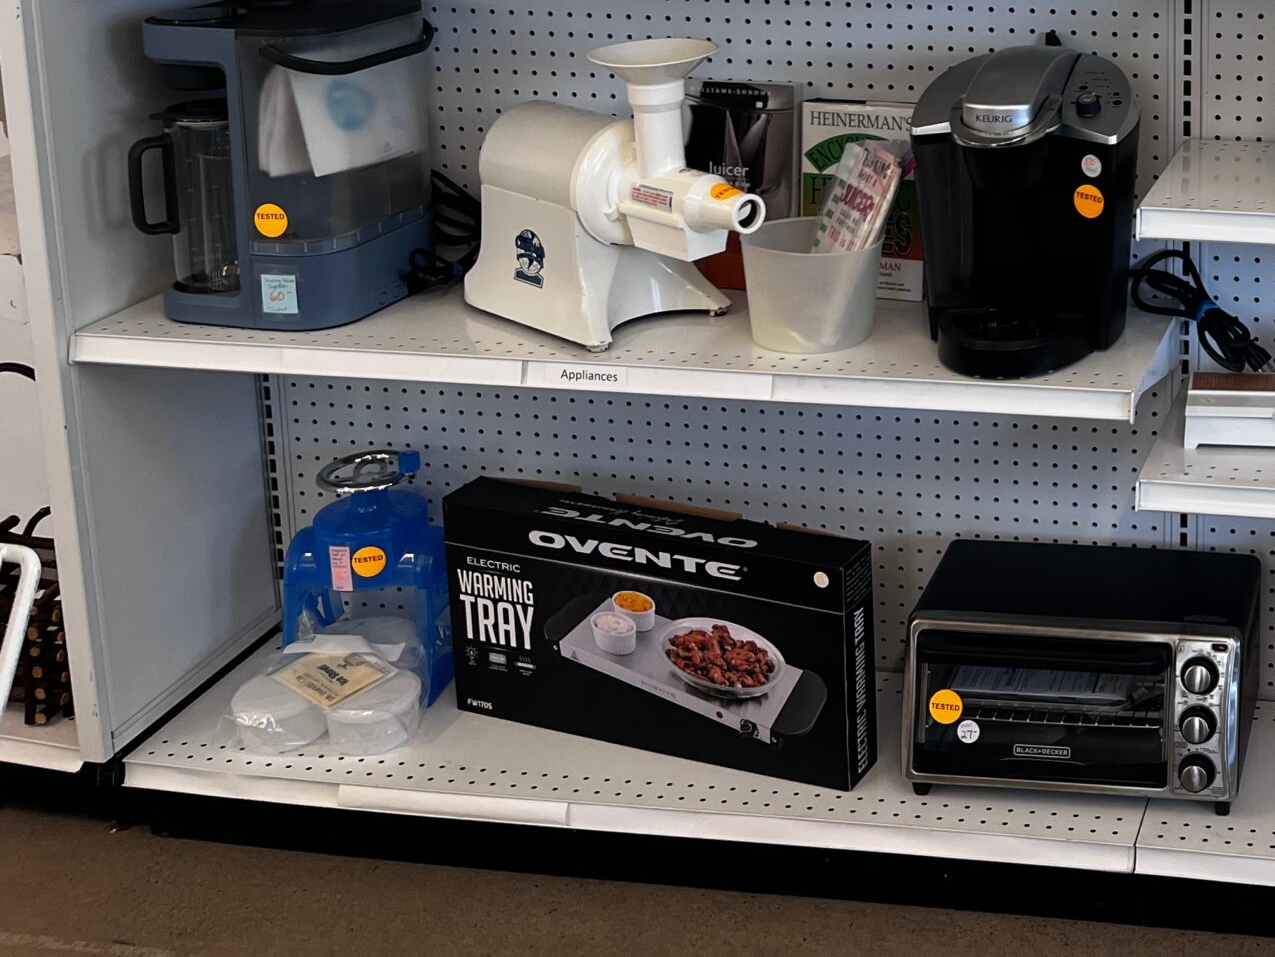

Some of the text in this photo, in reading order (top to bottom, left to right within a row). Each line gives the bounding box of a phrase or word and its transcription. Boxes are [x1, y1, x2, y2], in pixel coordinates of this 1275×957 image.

[810, 110, 913, 132] HEINERMAN'S
[975, 114, 1013, 124] KEURIG
[1076, 191, 1103, 204] TESTED
[560, 369, 618, 382] Appliances
[540, 506, 758, 548] OVENTE
[353, 555, 383, 563] TESTED
[529, 530, 742, 581] OVENTE
[467, 556, 521, 573] ELECTRIC
[457, 569, 534, 606] WARMING
[459, 594, 534, 650] TRAY
[854, 607, 868, 774] ELECTRIC WARMING TRAY
[467, 698, 493, 710] FW170S
[931, 702, 960, 711] TESTED
[1016, 747, 1068, 756] BLACK+DECKER
